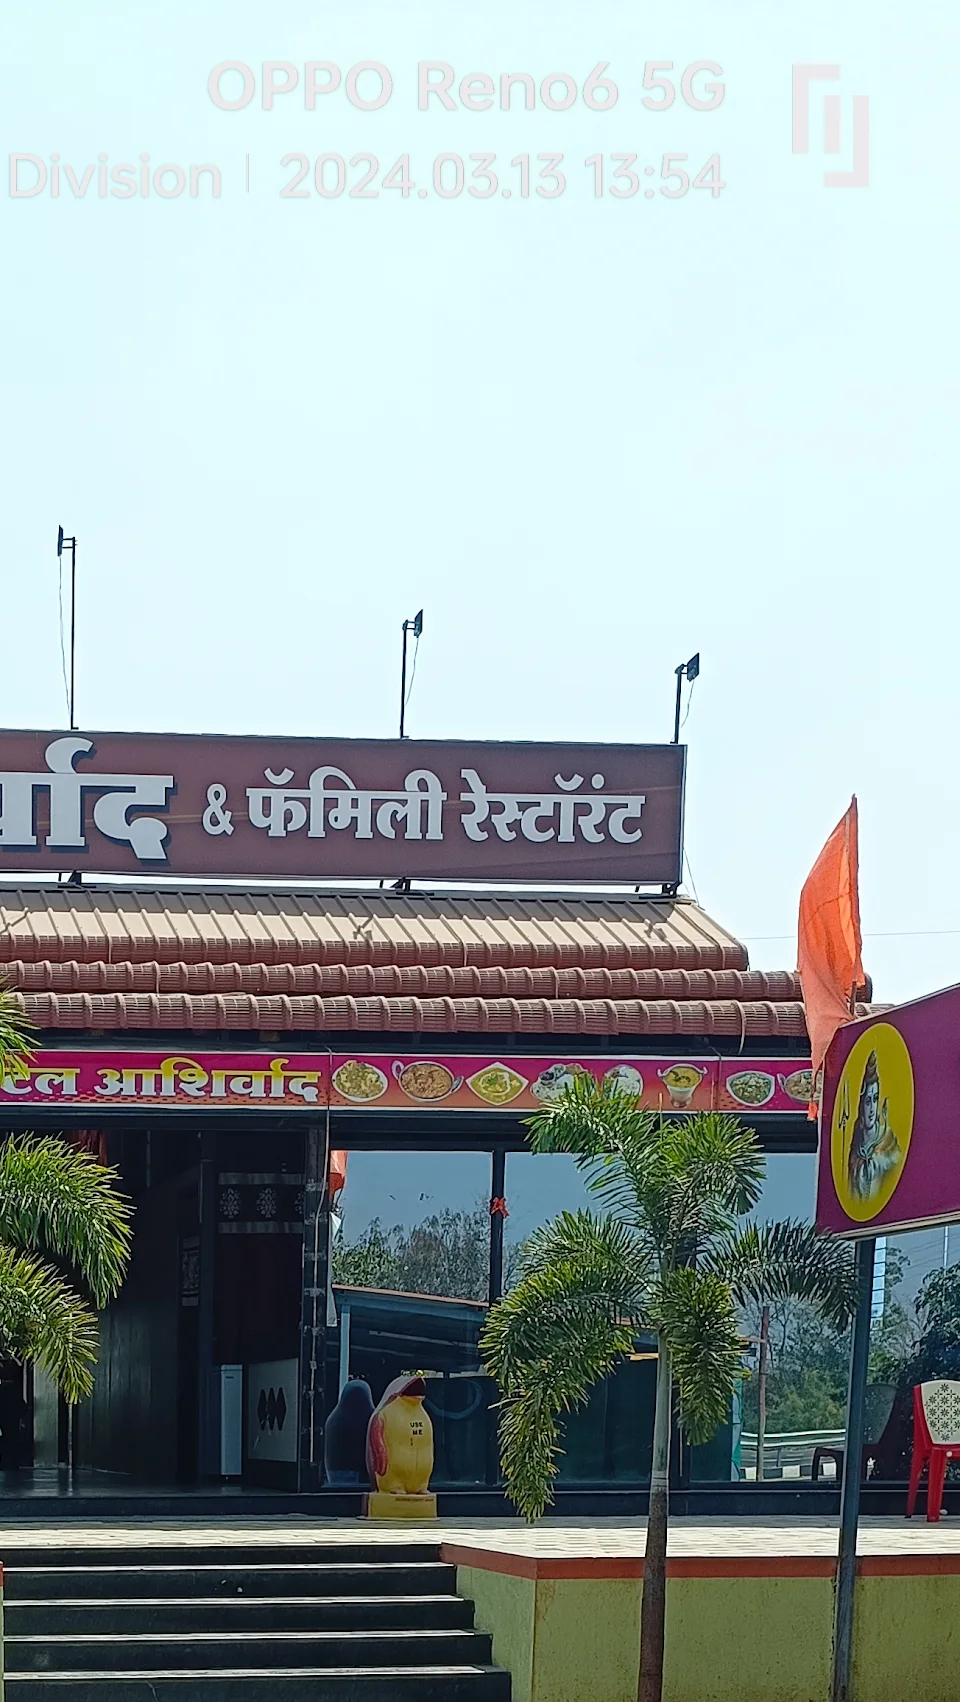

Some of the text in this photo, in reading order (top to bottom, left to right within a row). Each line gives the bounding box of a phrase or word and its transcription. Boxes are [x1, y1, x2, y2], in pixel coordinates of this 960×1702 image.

[201, 783, 234, 836] &
[246, 766, 447, 842] फॅमिली
[459, 768, 647, 845] रेस्टॉरंट
[93, 1056, 322, 1103] आशिर्वाद
